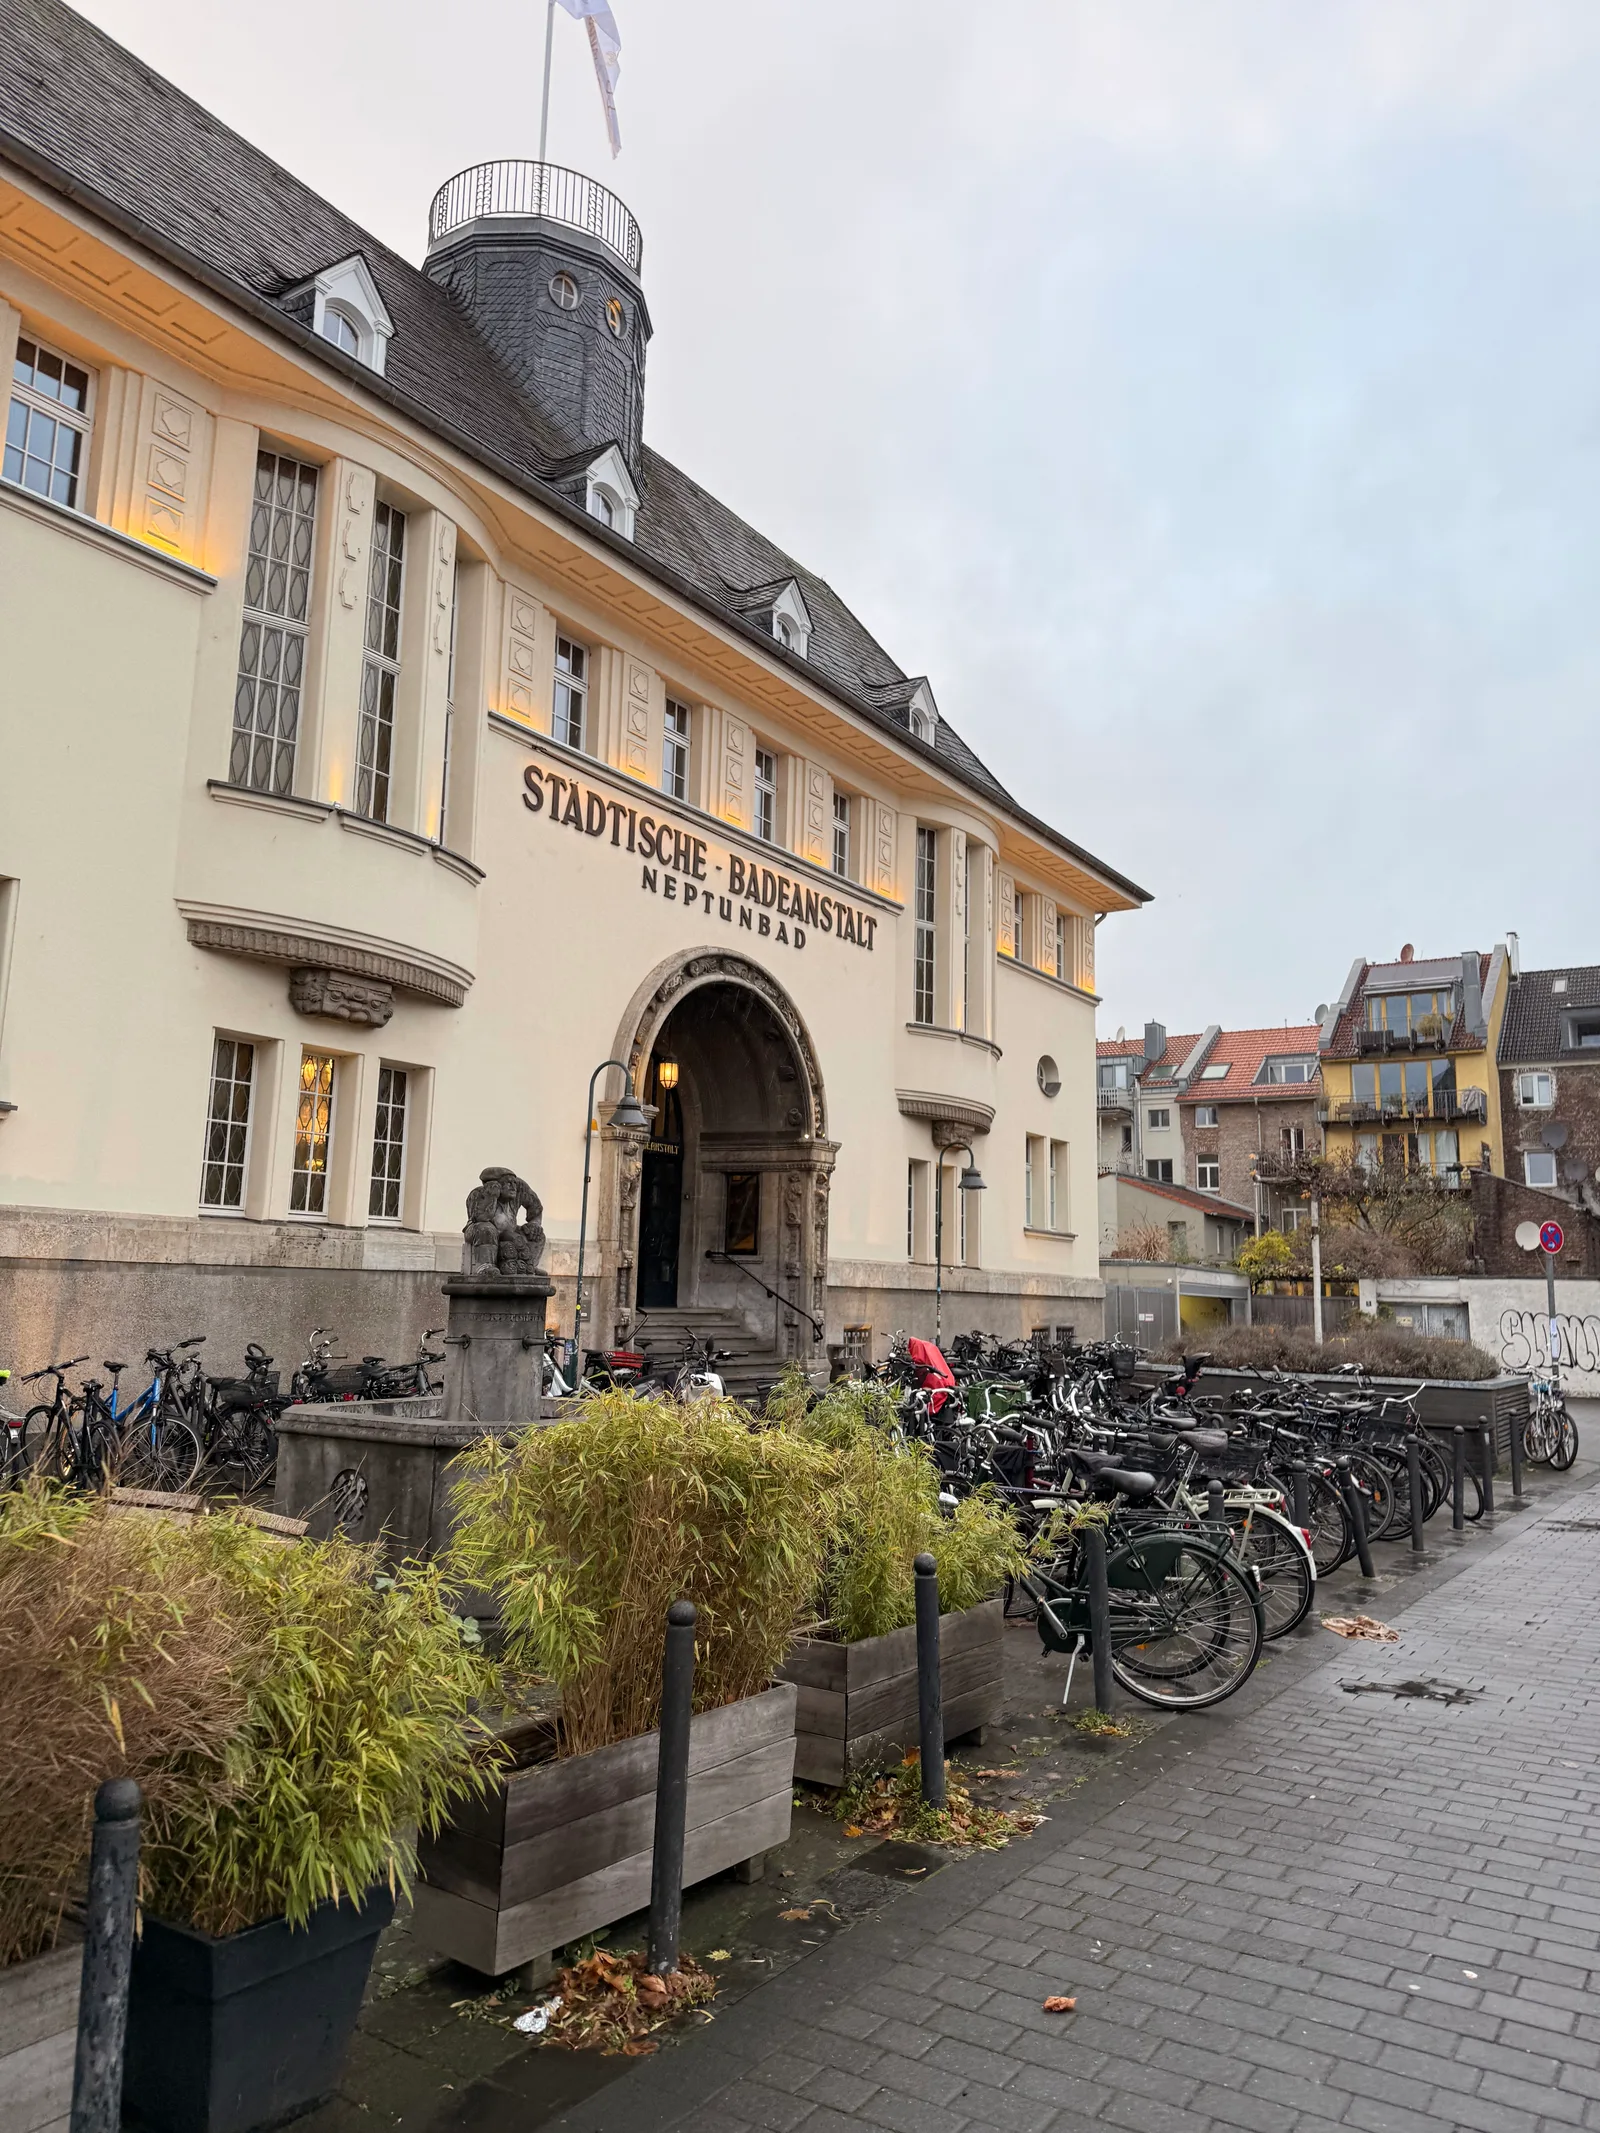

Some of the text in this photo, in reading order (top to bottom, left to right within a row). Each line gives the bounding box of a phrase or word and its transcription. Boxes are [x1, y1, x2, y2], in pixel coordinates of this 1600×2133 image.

[522, 765, 708, 881] STÄDTISCHE
[729, 853, 878, 951] BADEANSTALT
[641, 865, 807, 950] NEPTUNBAD
